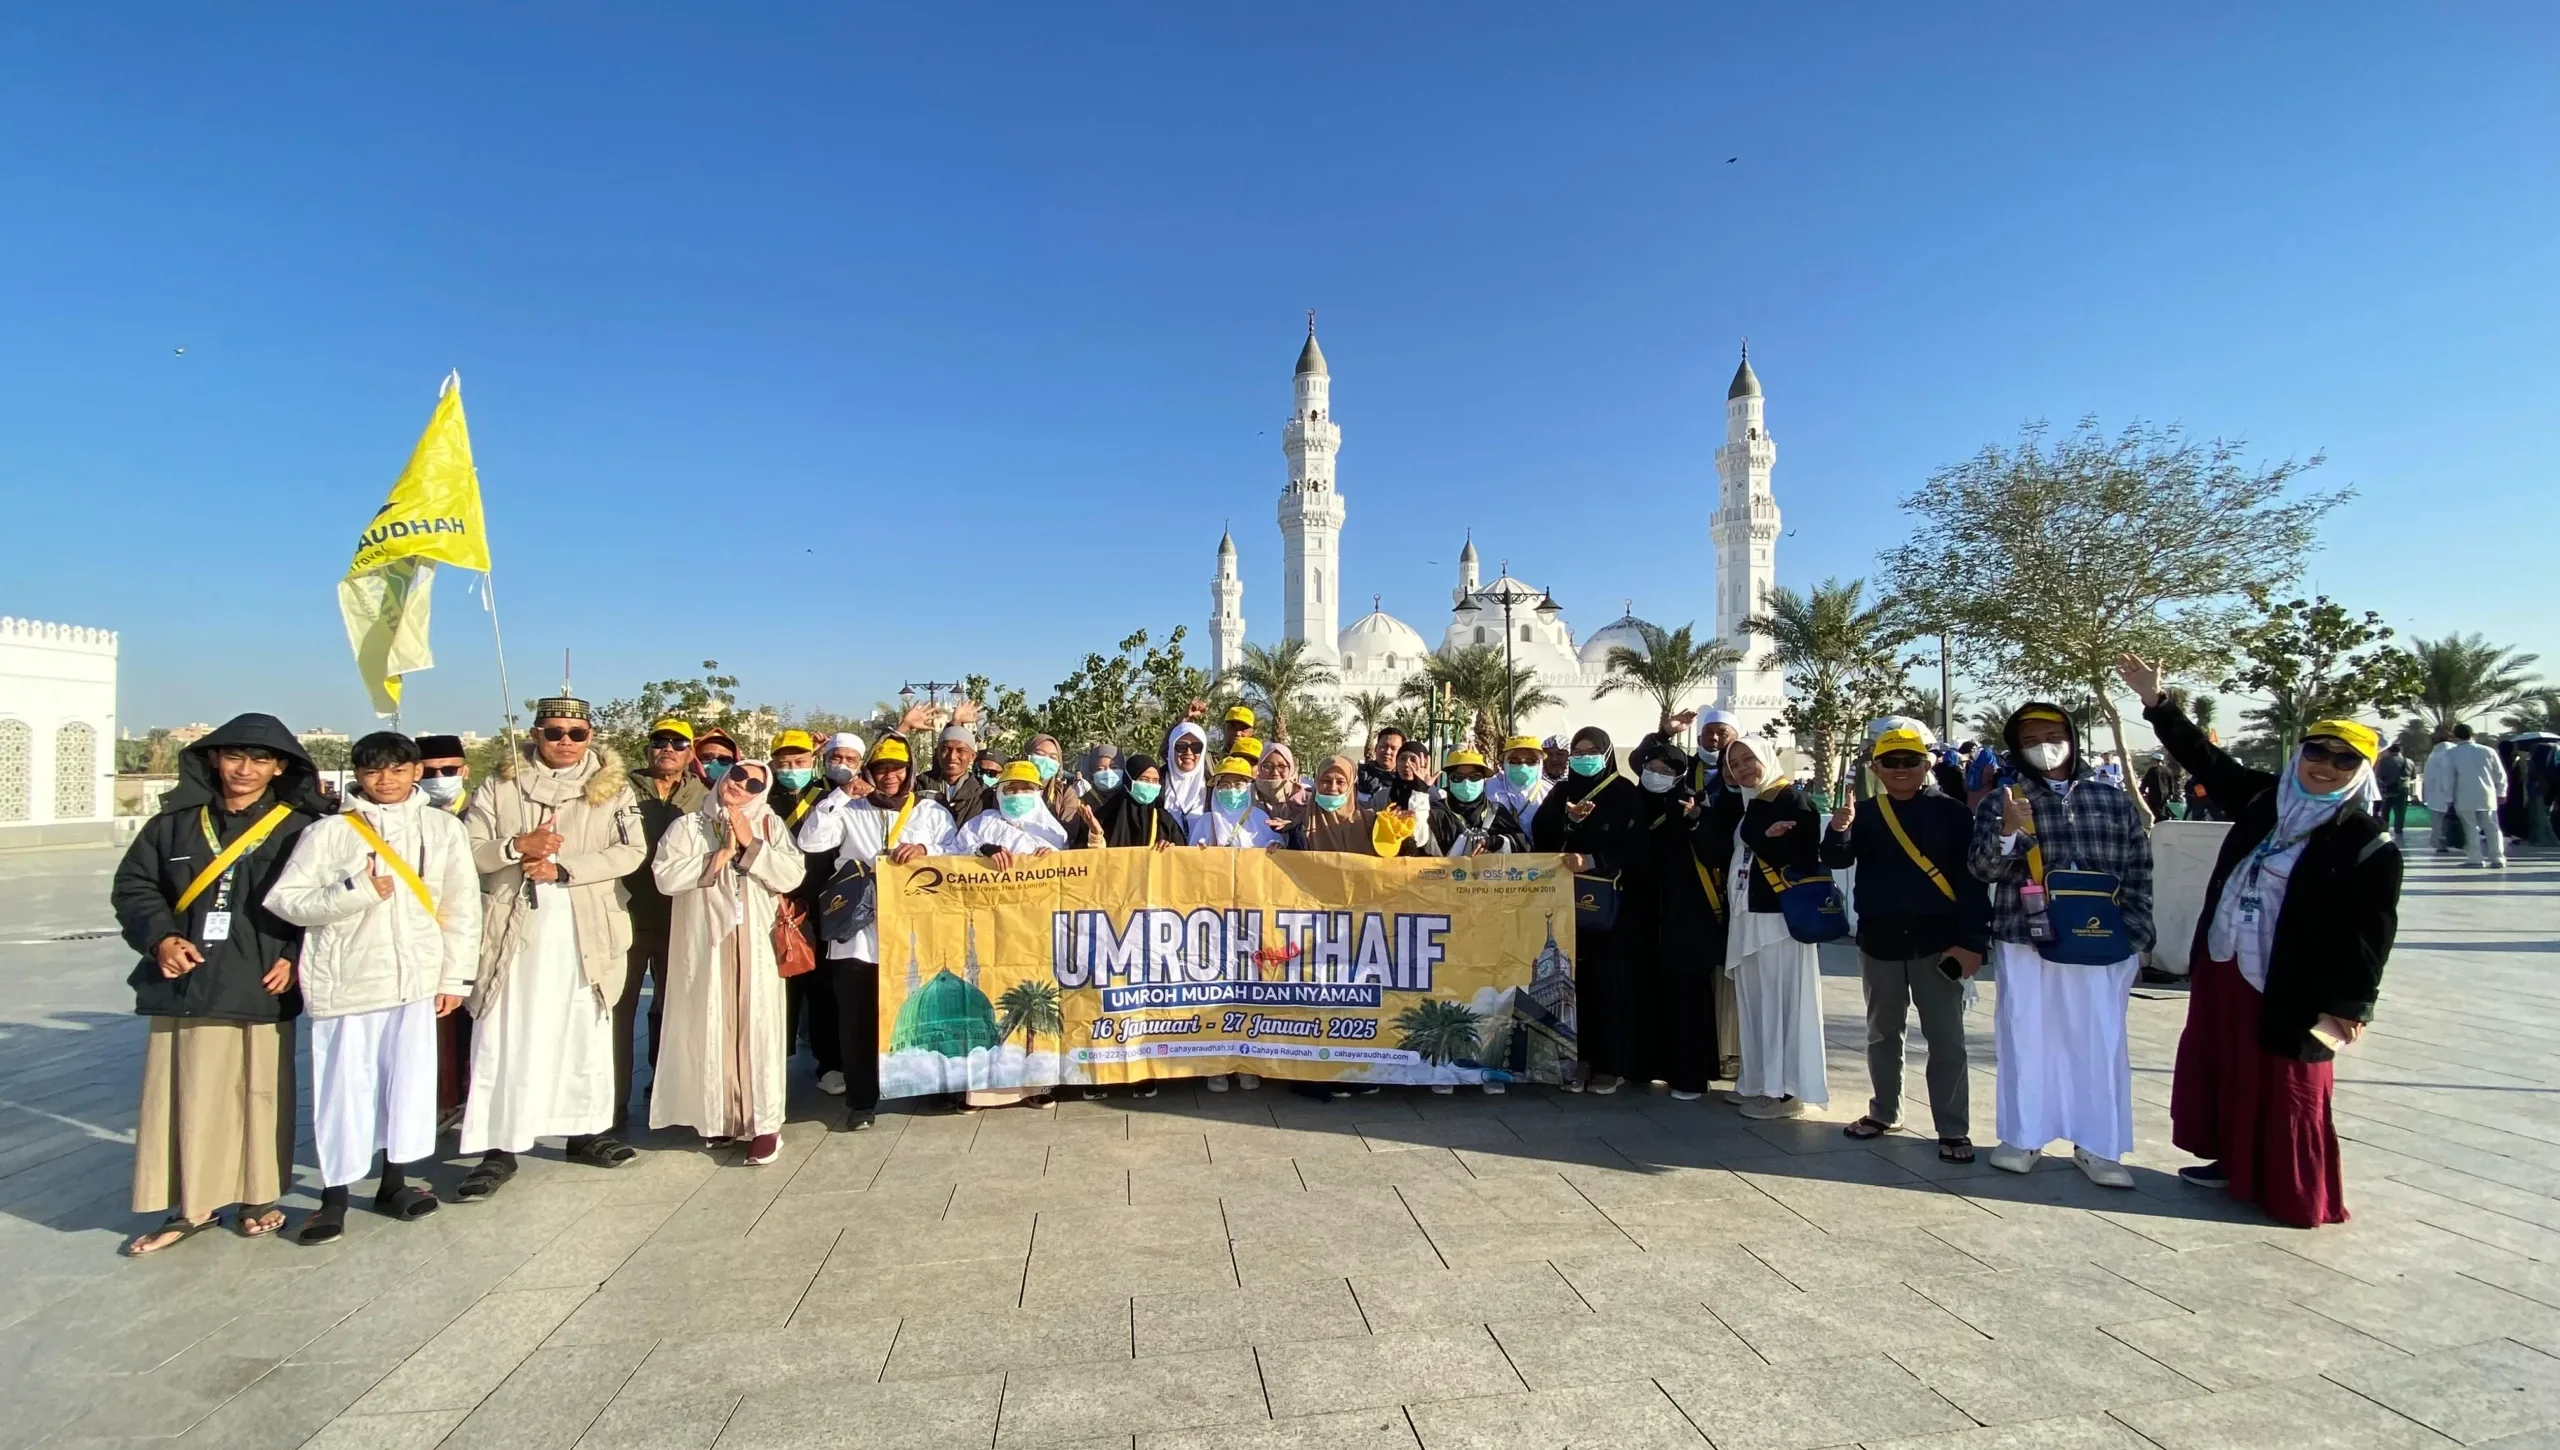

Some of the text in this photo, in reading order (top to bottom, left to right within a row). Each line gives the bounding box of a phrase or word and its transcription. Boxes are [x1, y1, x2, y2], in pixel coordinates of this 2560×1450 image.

[356, 517, 466, 554] AUDHAH
[946, 865, 1088, 885] CAHAYA RAUDHAH
[1002, 884, 1016, 892] Haji
[1024, 881, 1048, 890] Umroh
[1052, 907, 1450, 992] UMROH THAIF
[1111, 985, 1372, 1007] UMROH MUDAH DAN NYAMAN
[1092, 1019, 1113, 1039] 16
[1116, 1015, 1199, 1043] Januaari
[1222, 1012, 1244, 1033] 27
[1247, 1015, 1323, 1040] Januari
[1328, 1018, 1377, 1039] 2025
[1169, 1043, 1235, 1054] cahayaraudhah.id
[1251, 1046, 1313, 1057] Cahaya Raudhah
[1334, 1050, 1409, 1061] cahayaraudhah.com
